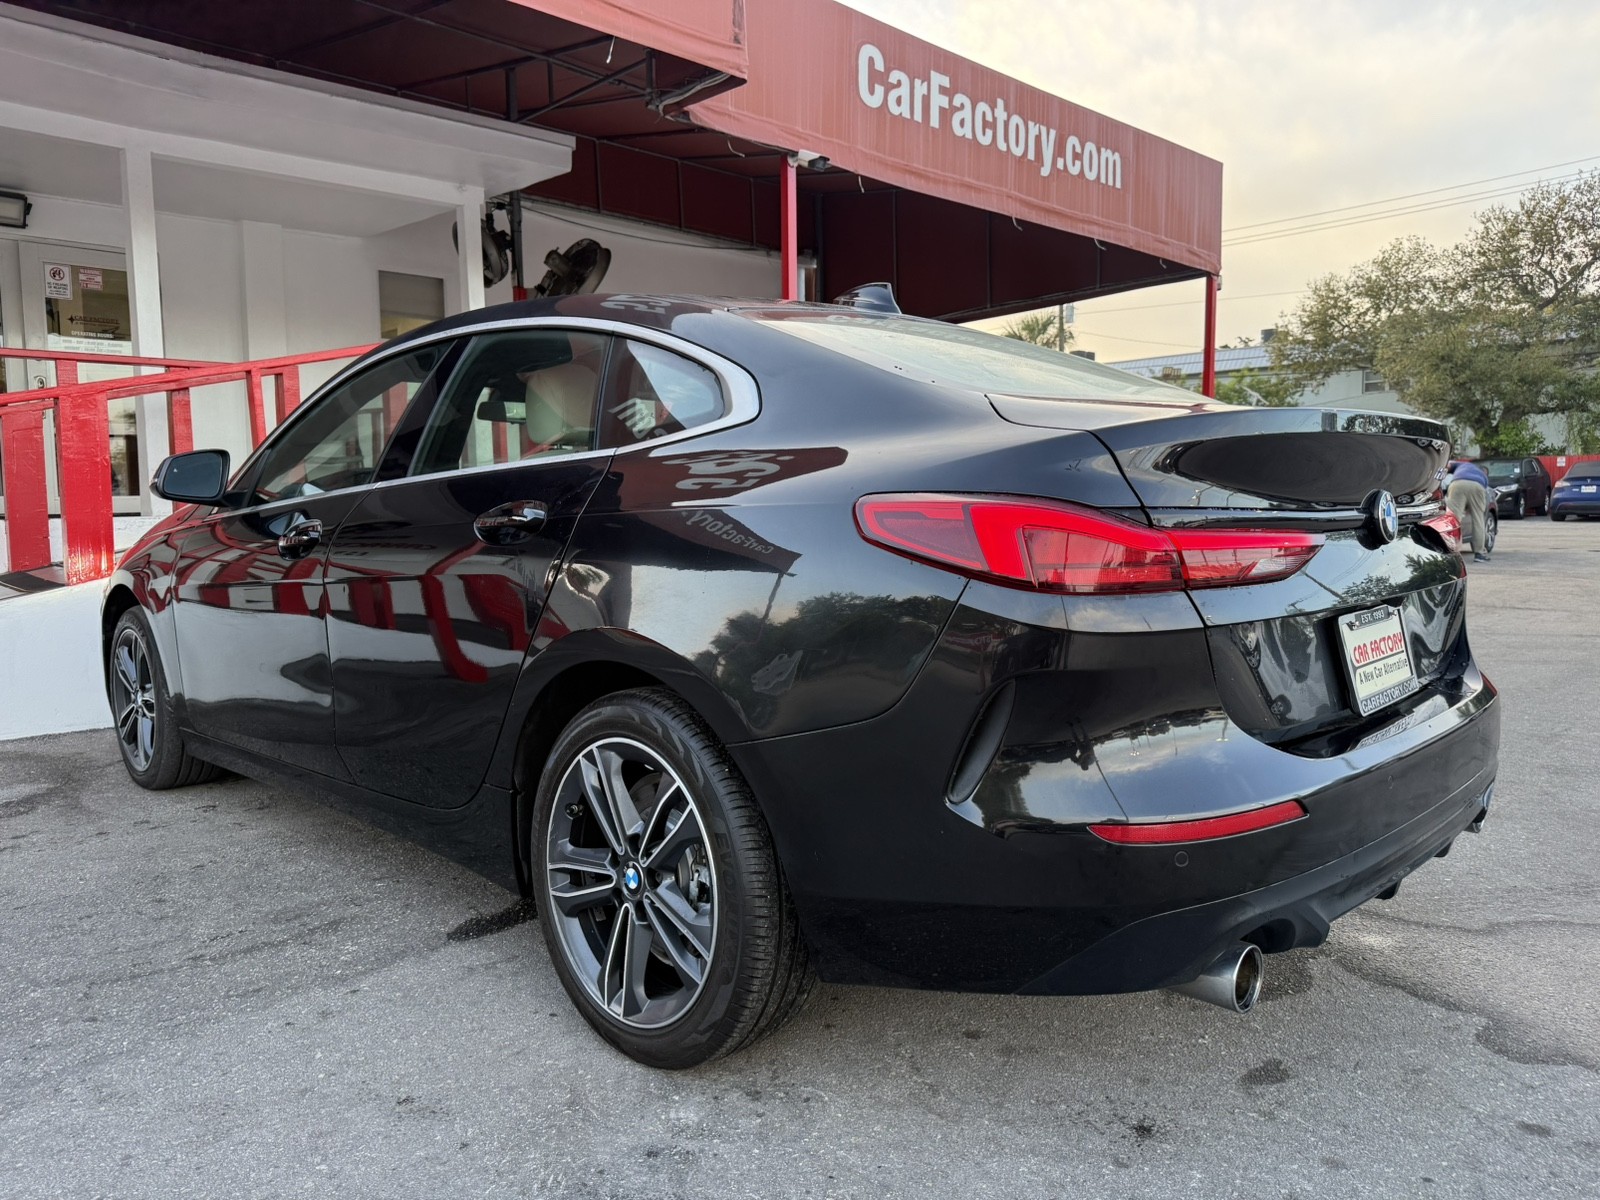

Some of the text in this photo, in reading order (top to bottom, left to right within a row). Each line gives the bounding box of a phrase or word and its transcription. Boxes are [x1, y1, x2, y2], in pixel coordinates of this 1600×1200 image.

[857, 43, 1122, 190] CarFactory.com
[1361, 609, 1385, 624] EST. 1993
[1353, 631, 1404, 664] CAR FACTORY
[1360, 658, 1408, 685] A New Car Alternative
[1361, 678, 1418, 713] CARFACTORY.COM
